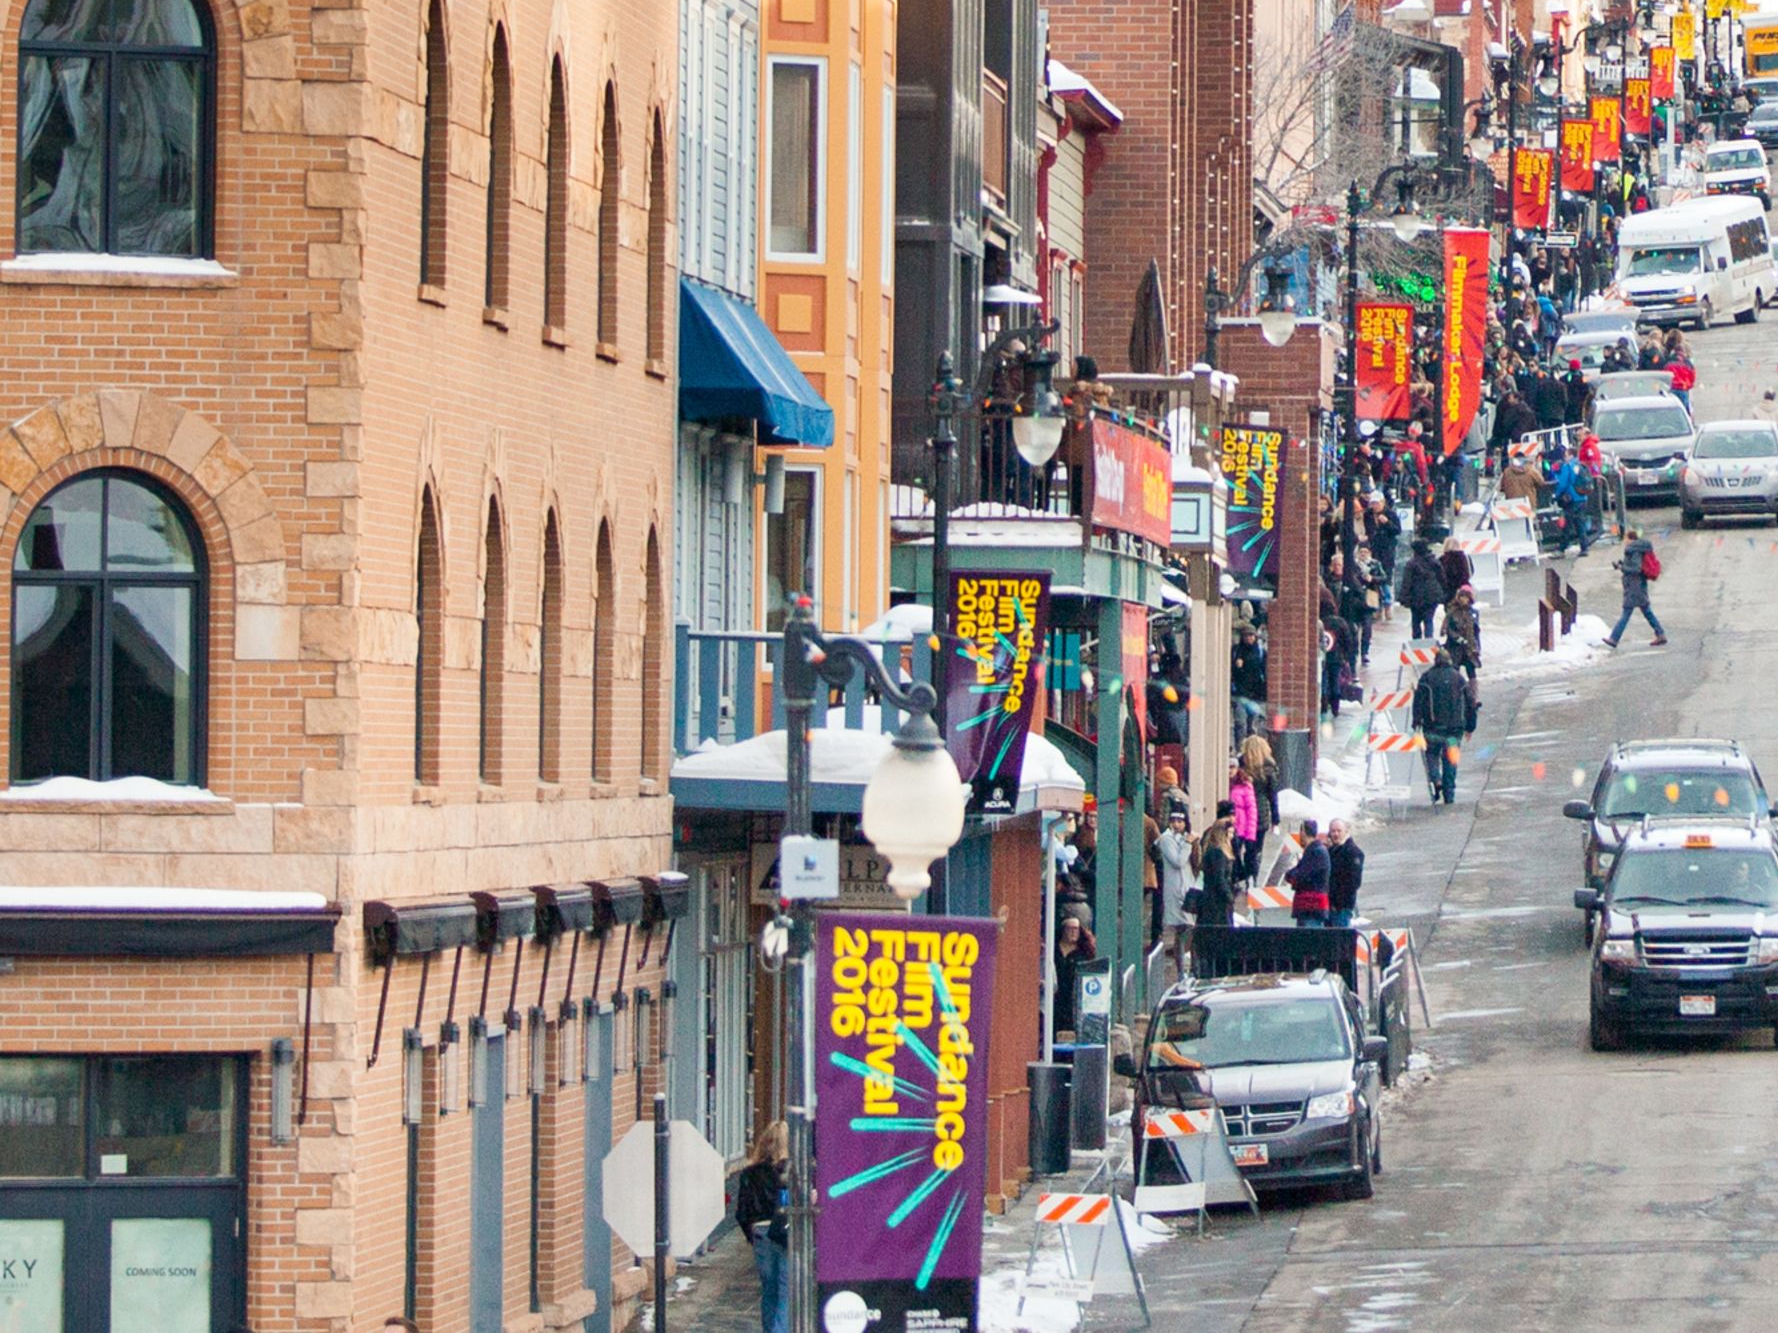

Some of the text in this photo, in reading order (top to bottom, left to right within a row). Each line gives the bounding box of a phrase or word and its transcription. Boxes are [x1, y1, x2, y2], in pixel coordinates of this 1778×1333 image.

[1360, 308, 1373, 341] 2016
[1372, 308, 1385, 366] Festival
[1395, 309, 1408, 384] Sundance
[1447, 255, 1467, 423] Filmmaker Lodge
[1222, 428, 1237, 473] 2016
[1234, 430, 1252, 505] Festival
[1261, 432, 1281, 530] Sundance
[956, 579, 978, 640] 2016
[976, 579, 999, 684] Festival
[998, 579, 1019, 635] Film
[1003, 579, 1041, 713] Sundance
[984, 800, 1011, 809] ACURA
[830, 926, 869, 1039] 2016
[903, 931, 941, 1029] Film
[864, 929, 906, 1114] Festival
[934, 932, 979, 1171] Sundance
[126, 1267, 197, 1277] COMING SOON
